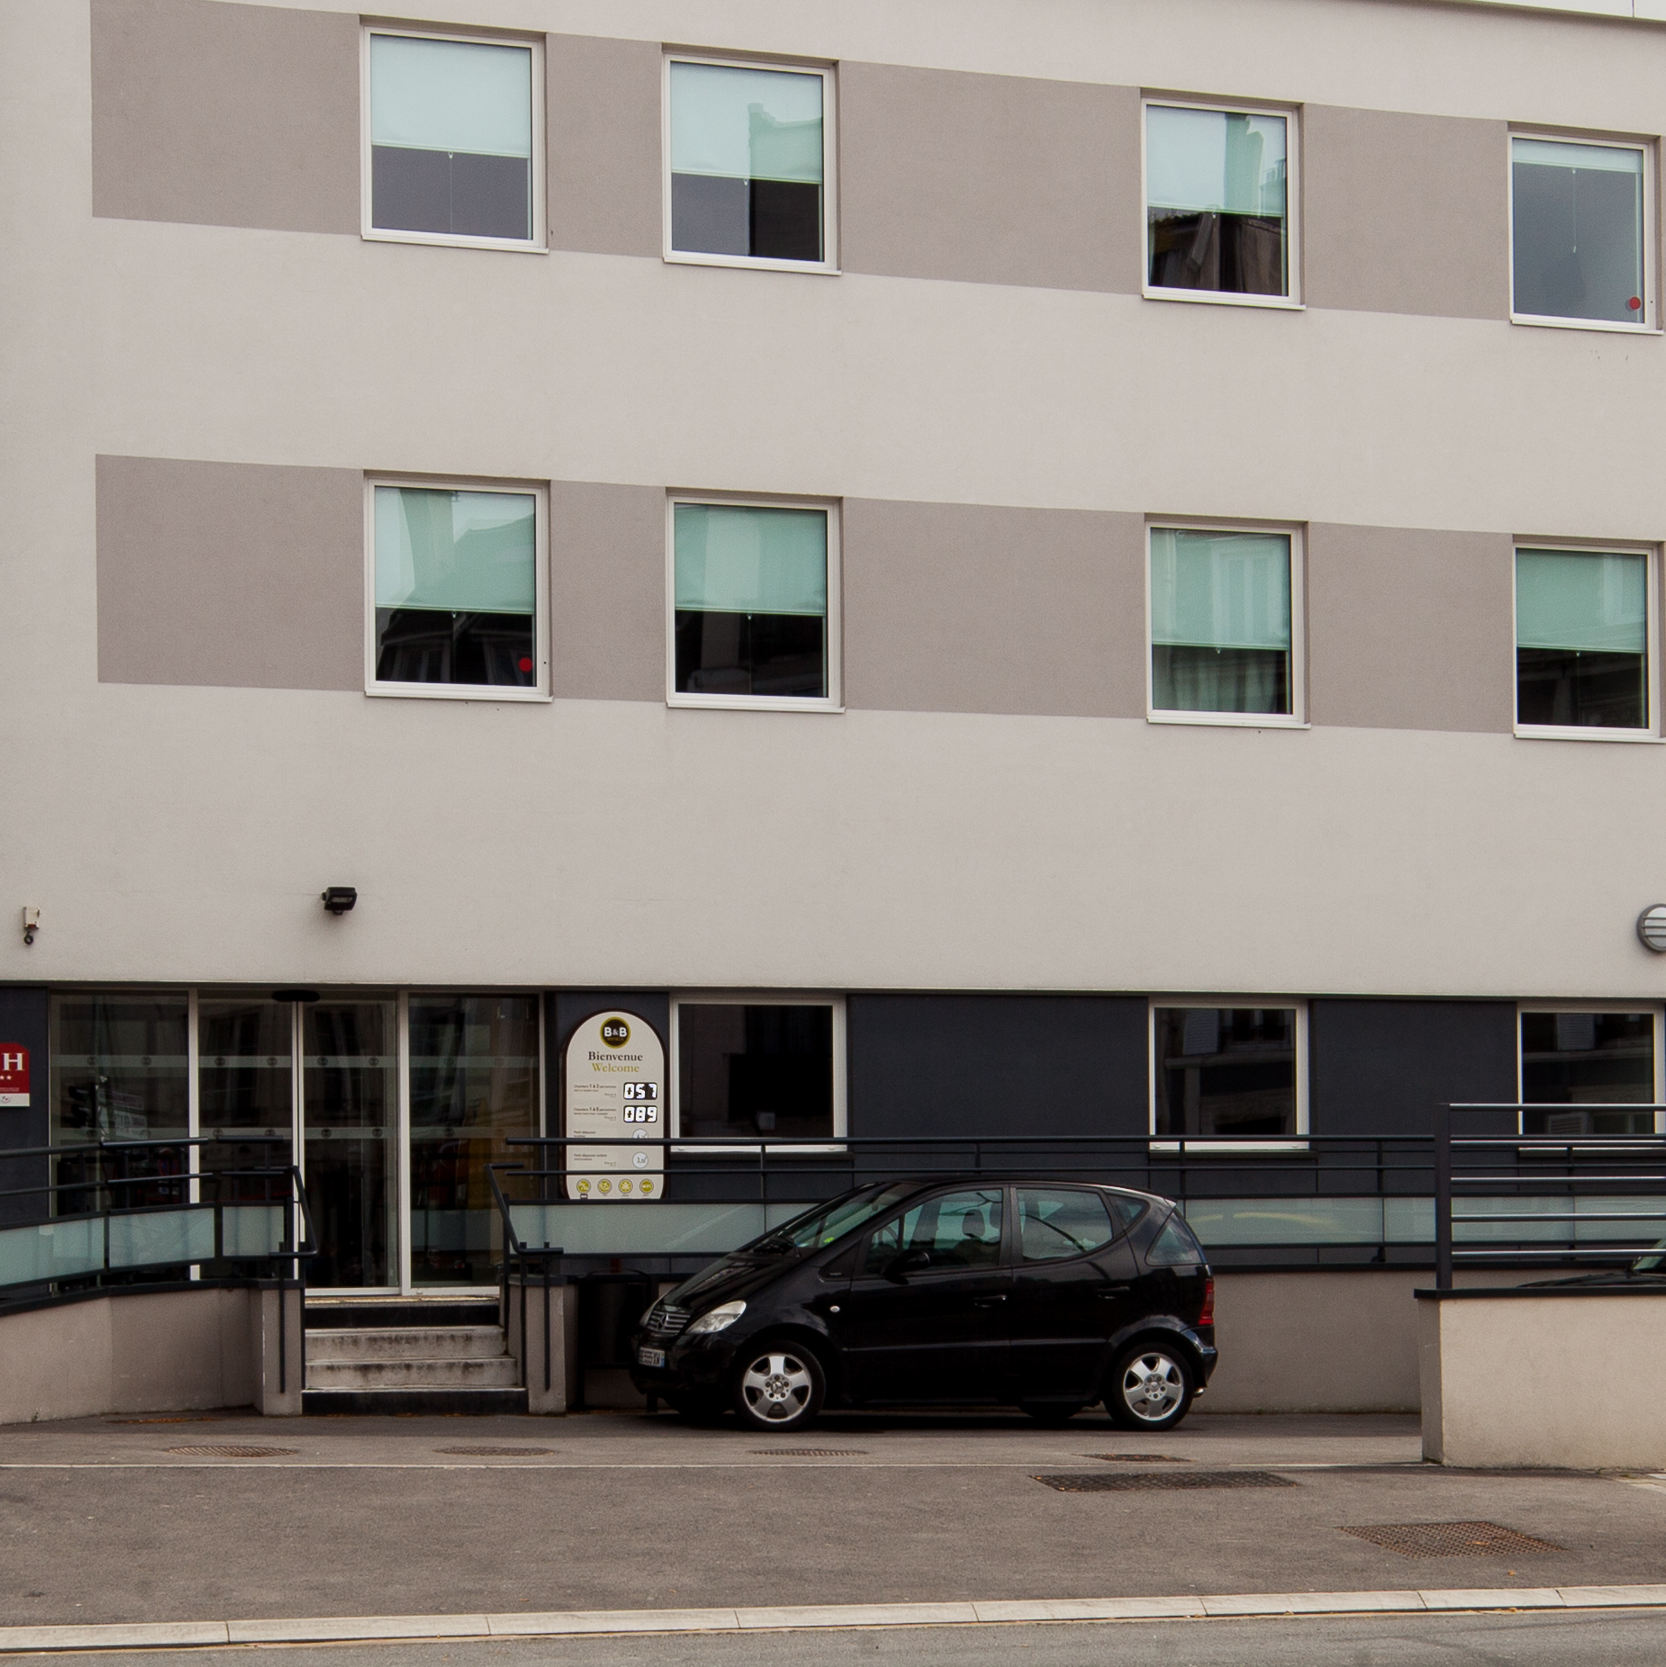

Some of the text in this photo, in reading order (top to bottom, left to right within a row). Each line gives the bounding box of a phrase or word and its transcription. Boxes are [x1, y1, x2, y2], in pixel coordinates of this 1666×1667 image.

[604, 1026, 628, 1037] B&B
[588, 1051, 643, 1061] Bienvenue
[2, 1052, 25, 1071] H
[591, 1062, 640, 1072] Welcome
